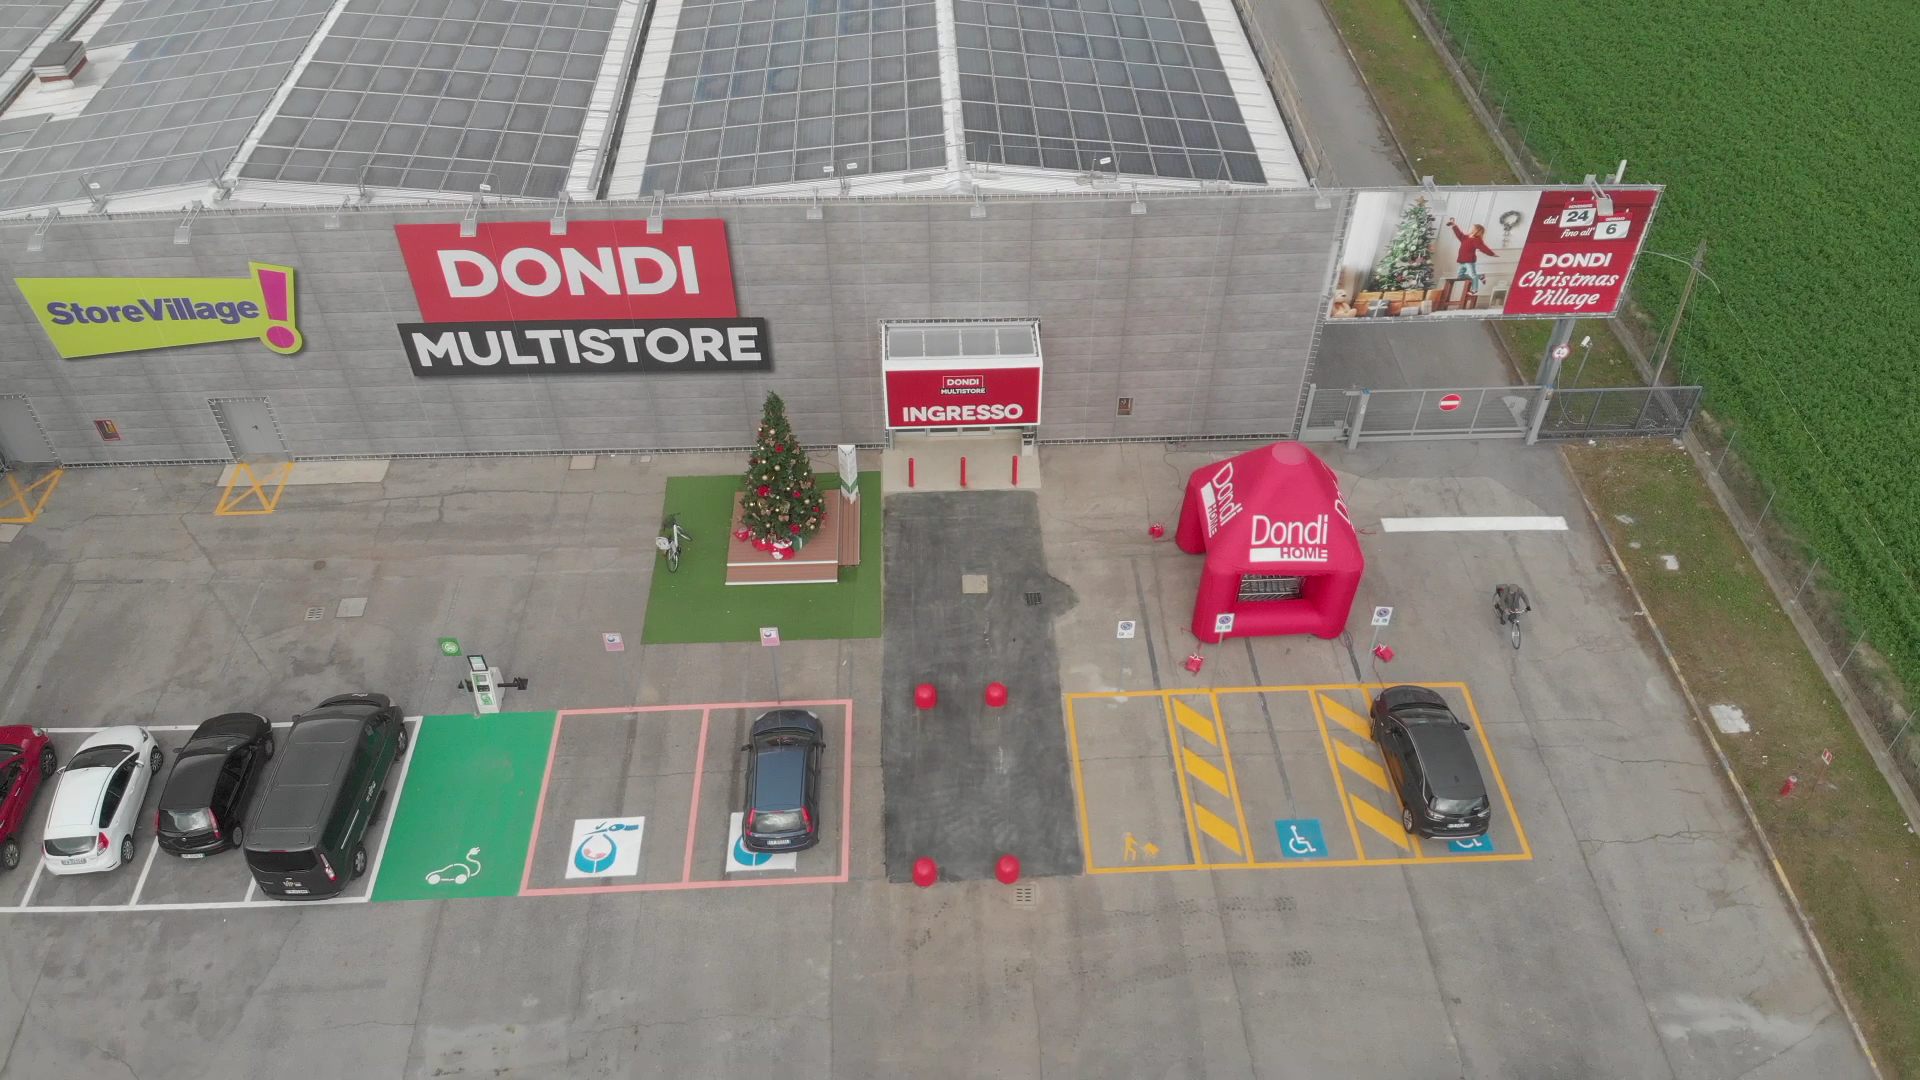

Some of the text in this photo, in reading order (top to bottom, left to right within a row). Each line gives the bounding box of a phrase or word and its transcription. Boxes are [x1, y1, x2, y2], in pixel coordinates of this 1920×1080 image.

[1544, 210, 1588, 224] dal 24
[1560, 228, 1579, 239] fino
[1606, 224, 1617, 234] 6
[1541, 253, 1612, 267] DONDI
[436, 245, 700, 298] DONDI
[1518, 270, 1620, 288] Christmas
[1531, 288, 1601, 310] Village
[414, 326, 763, 369] MULTISTORE
[940, 387, 986, 395] MULTISTORE
[902, 403, 1024, 423] INGRESSO
[1212, 461, 1243, 527] Dondi
[1207, 503, 1219, 537] HOME
[1251, 513, 1329, 546] Dondi
[1280, 546, 1328, 560] HOME
